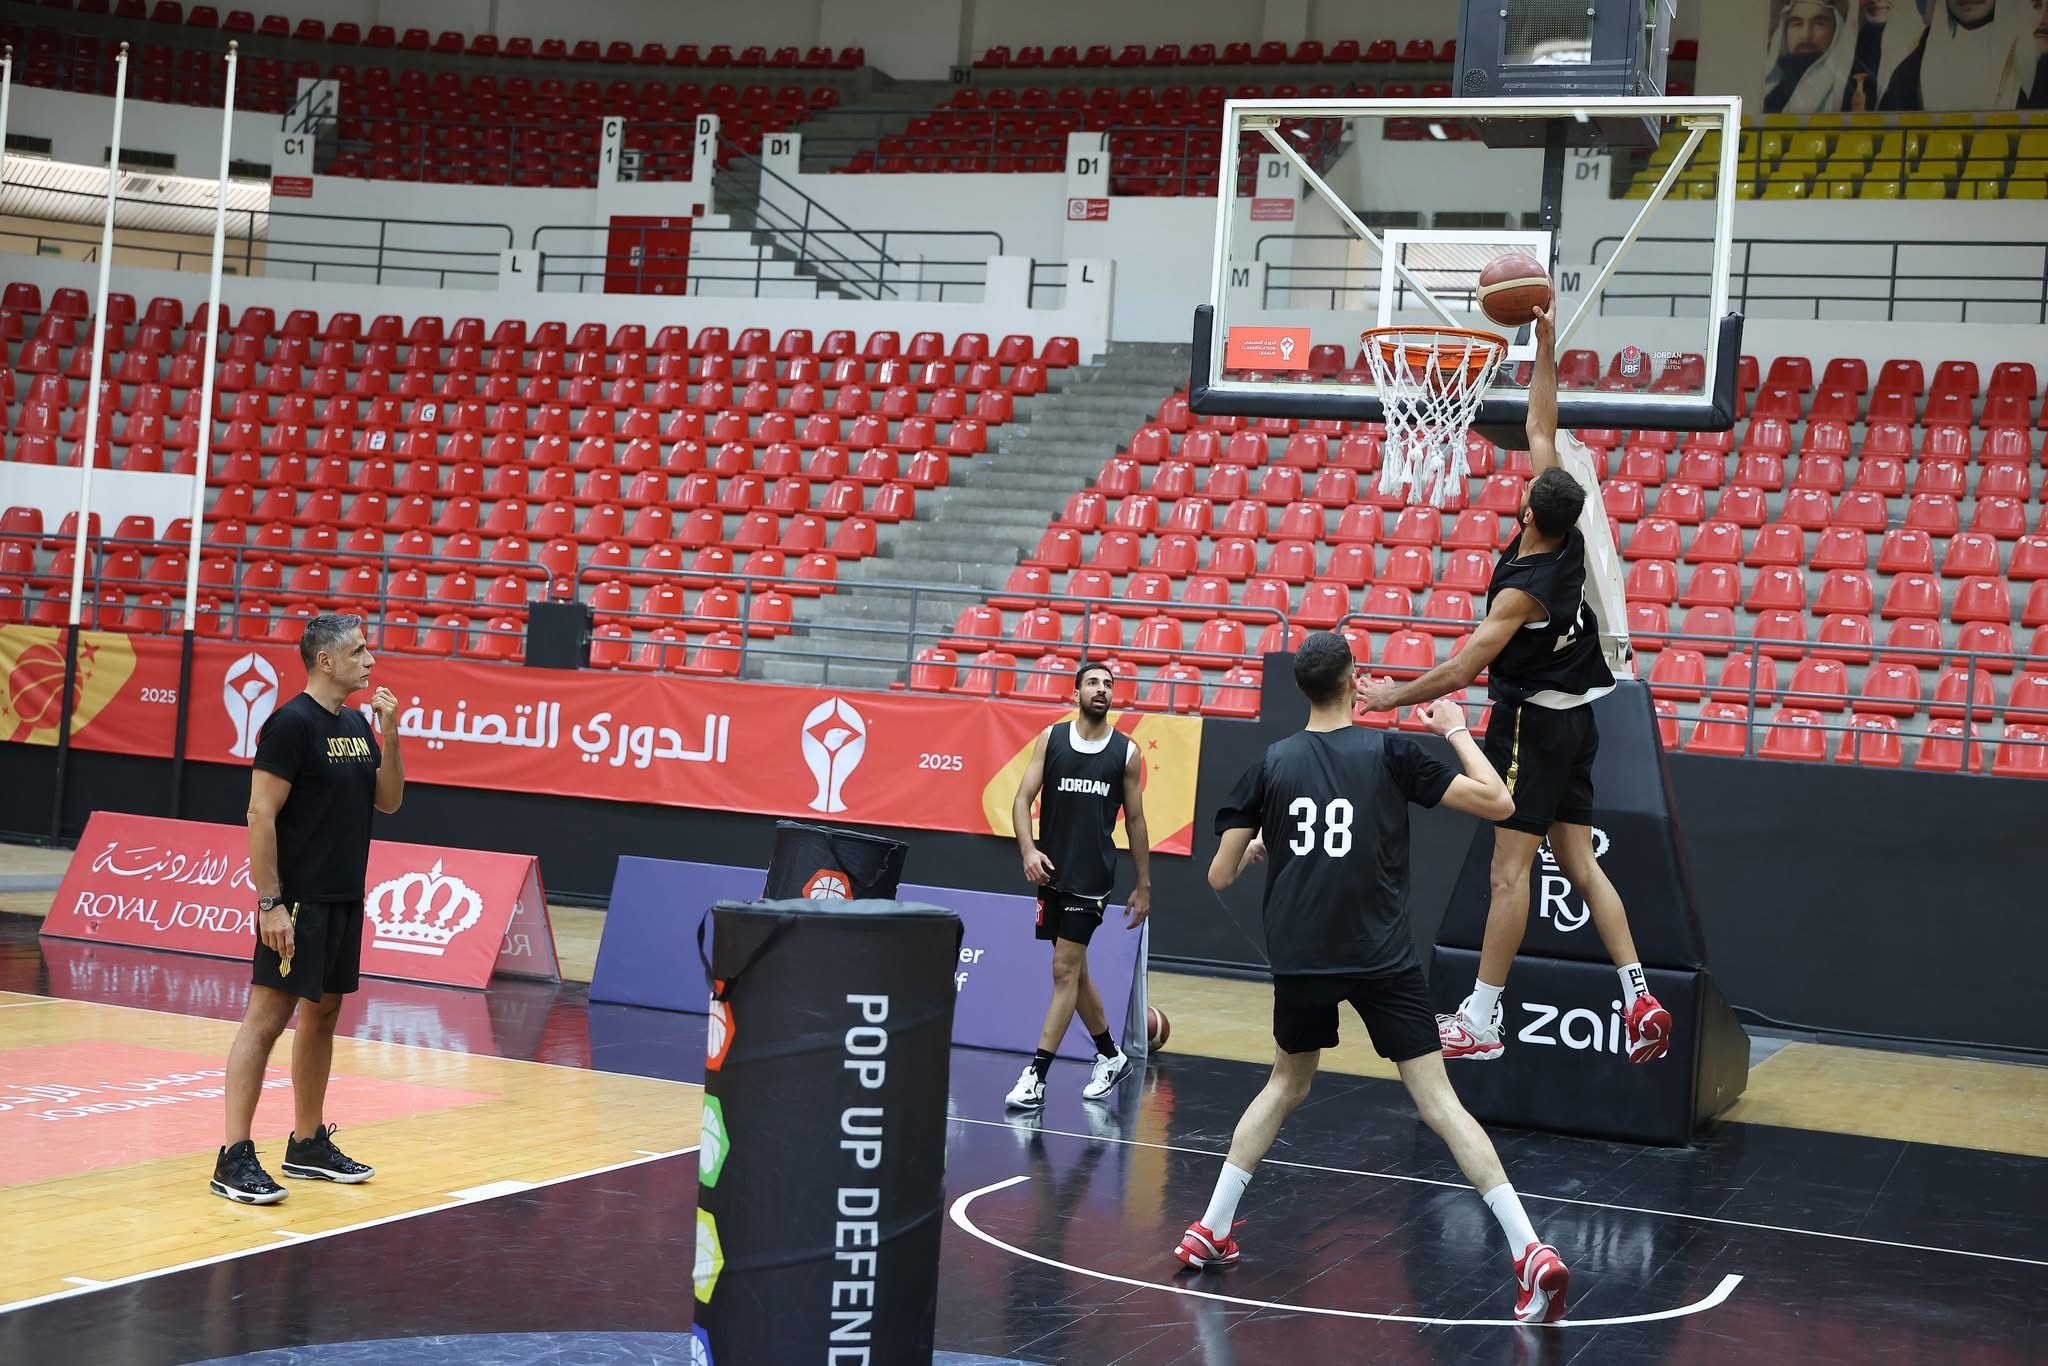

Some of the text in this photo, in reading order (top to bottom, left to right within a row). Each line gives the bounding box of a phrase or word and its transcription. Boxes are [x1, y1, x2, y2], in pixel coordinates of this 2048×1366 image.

[953, 69, 972, 84] D1
[284, 138, 305, 155] C1
[771, 139, 791, 156] D1
[1077, 157, 1099, 175] D1
[1267, 160, 1291, 179] D1
[1575, 162, 1600, 181] D1
[512, 255, 522, 272] L
[1082, 265, 1095, 283] L
[1231, 268, 1250, 288] M
[1561, 271, 1581, 292] M
[1652, 351, 1682, 359] JORDAN
[1622, 365, 1639, 374] JBF
[141, 687, 177, 704] 2025
[326, 737, 371, 757] JORDAN
[572, 712, 731, 769] الدوري
[918, 753, 963, 771] 2025
[1057, 777, 1111, 797] JORDAN
[1288, 796, 1354, 858] 38
[73, 891, 257, 936] ROYAL JORDA
[1518, 999, 1640, 1058] zai
[843, 993, 889, 1089] POP
[24, 1090, 193, 1121] JORDAN
[840, 1107, 884, 1169] UP
